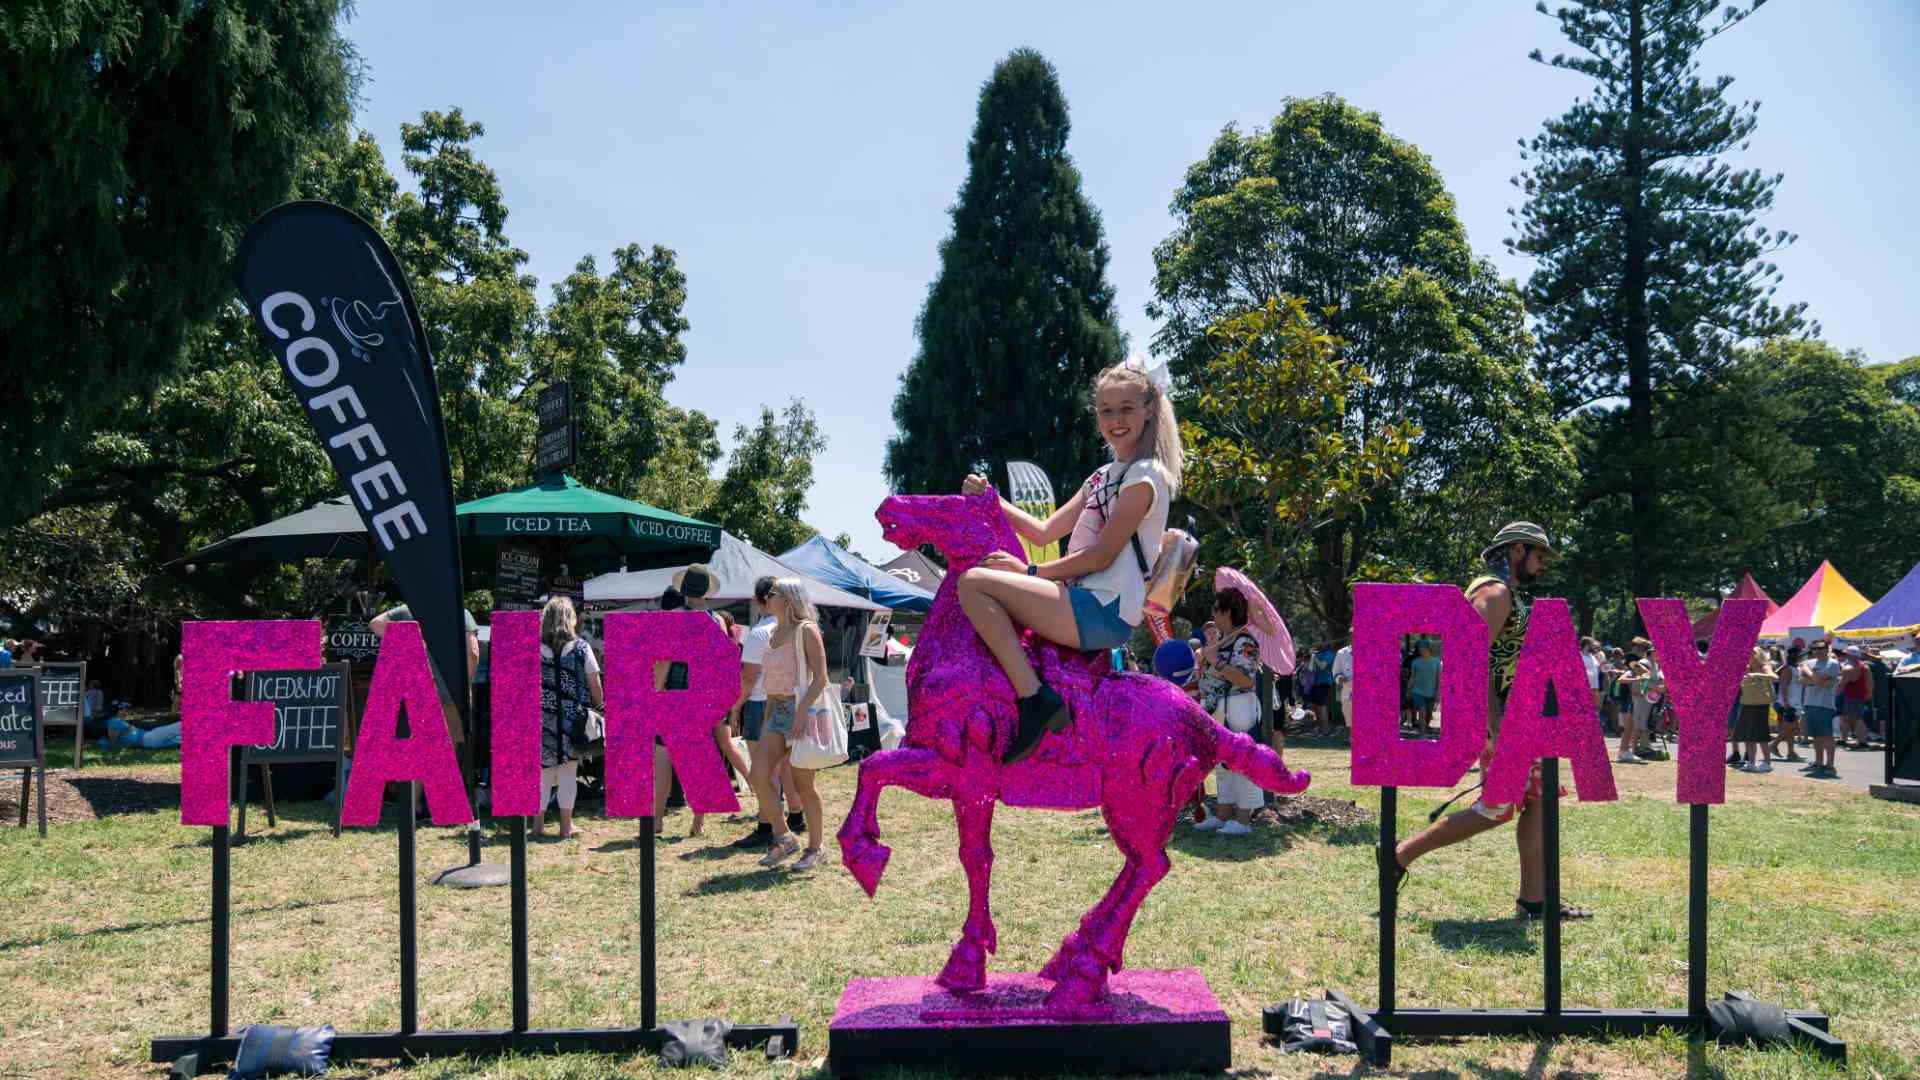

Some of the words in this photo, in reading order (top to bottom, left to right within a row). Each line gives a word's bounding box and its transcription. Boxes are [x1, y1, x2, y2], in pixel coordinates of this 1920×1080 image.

[260, 290, 428, 552] COFFEE
[505, 517, 551, 532] ICED
[555, 517, 592, 532] TEA
[635, 518, 664, 537] ICED
[665, 524, 713, 544] COFFEE
[330, 632, 380, 648] COFFE
[180, 609, 742, 827] FAIR
[1350, 582, 1769, 807] DAY
[253, 705, 340, 750] OFFEE
